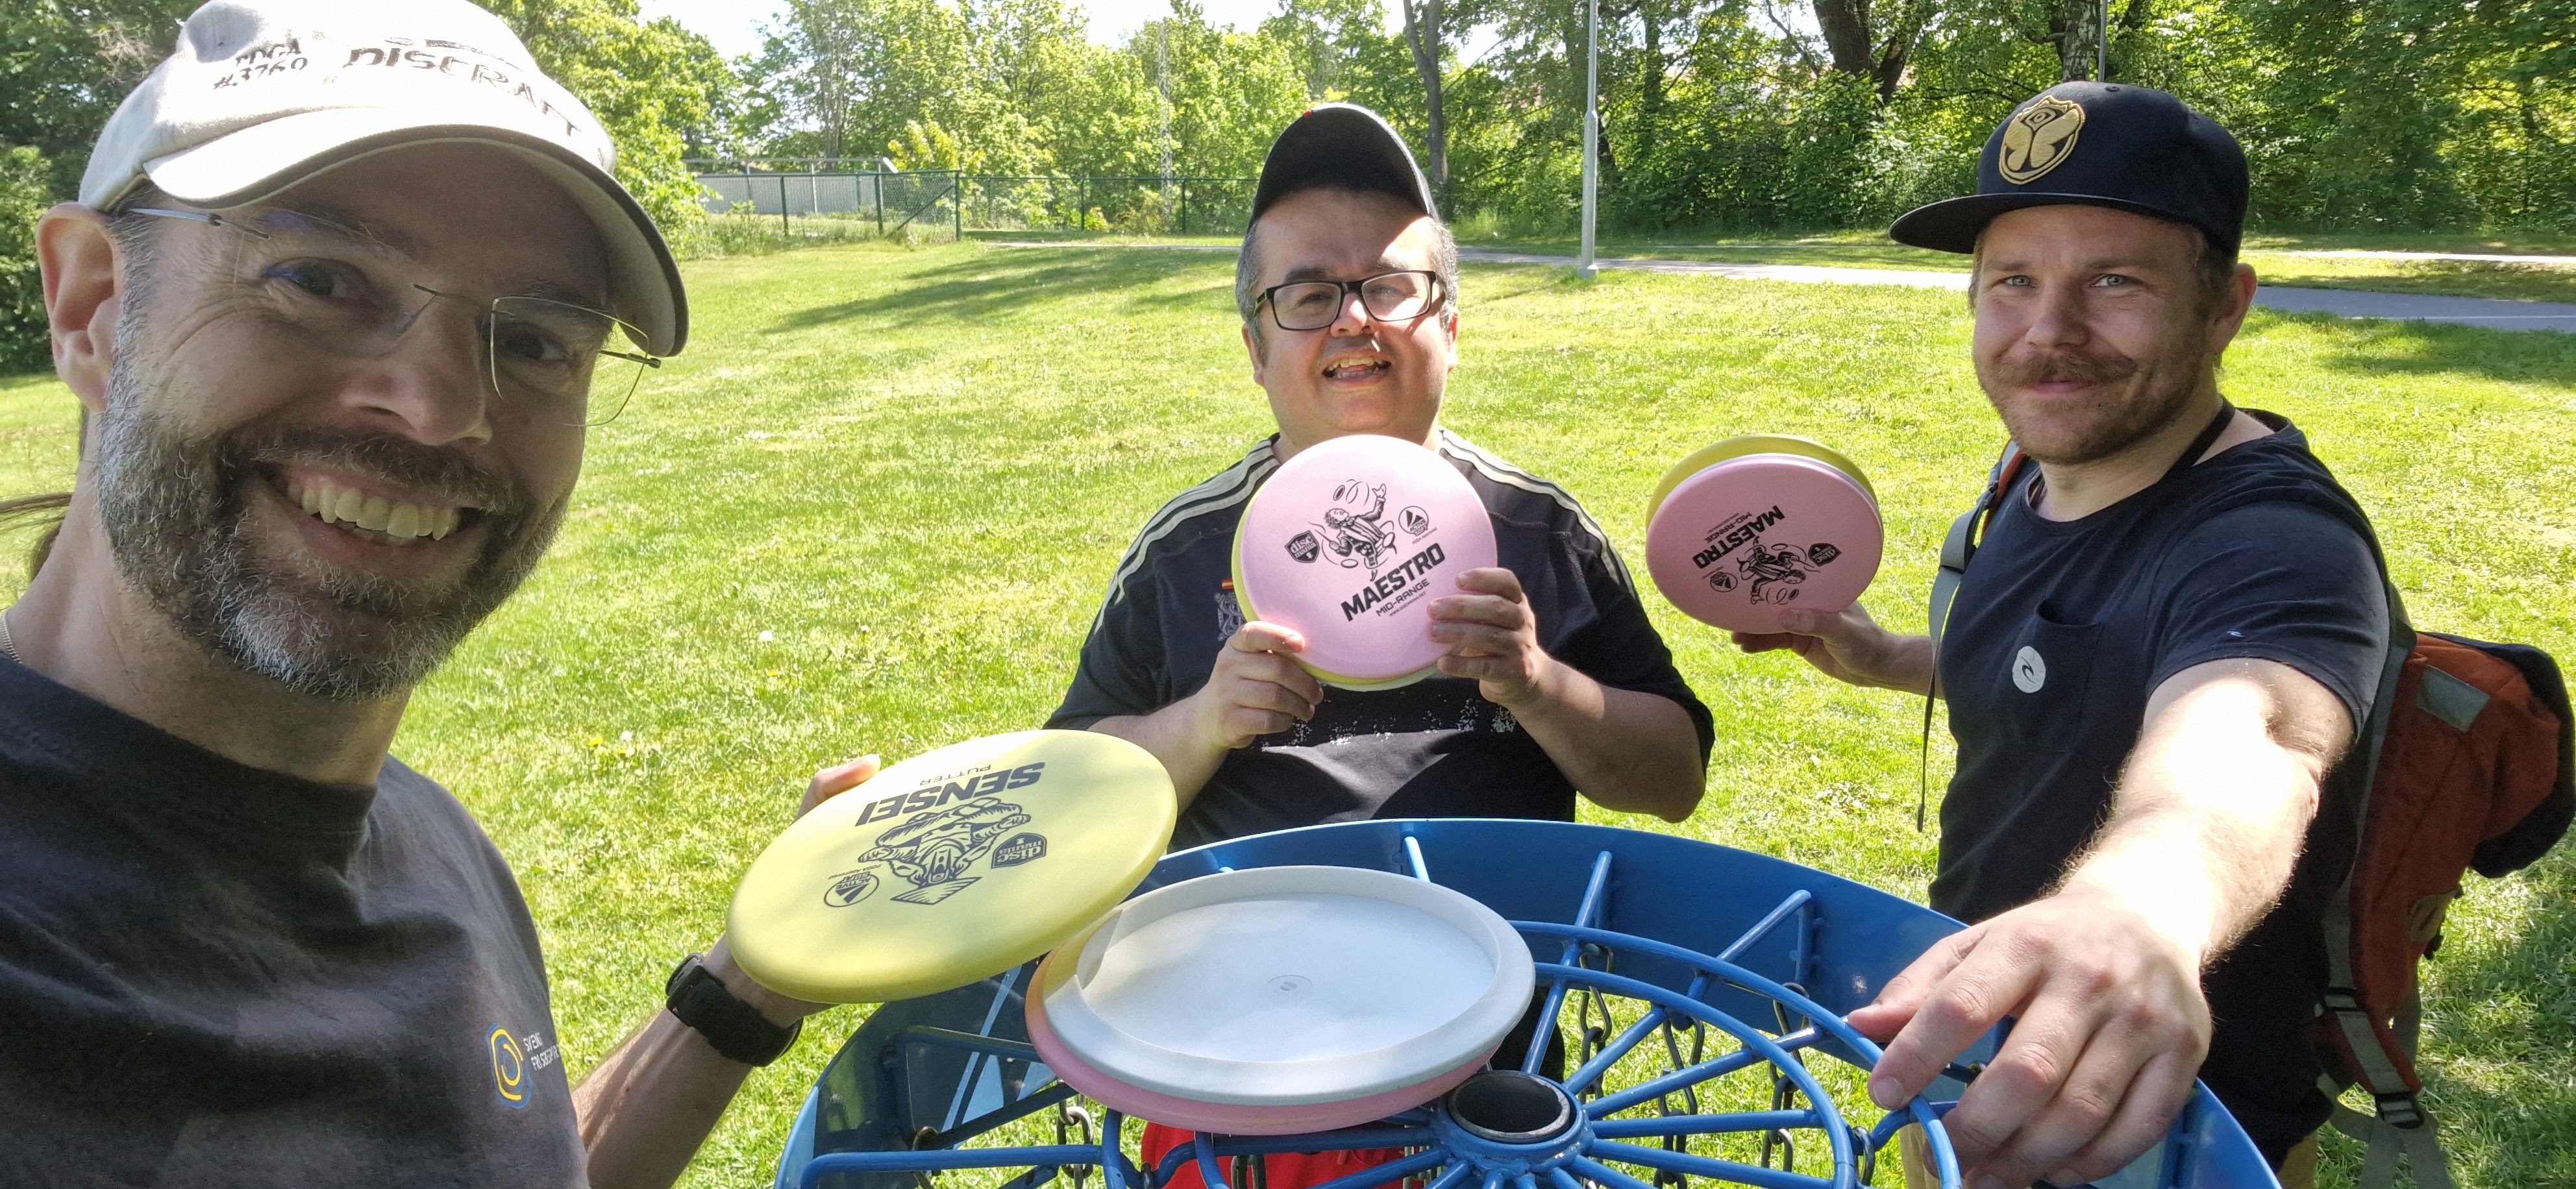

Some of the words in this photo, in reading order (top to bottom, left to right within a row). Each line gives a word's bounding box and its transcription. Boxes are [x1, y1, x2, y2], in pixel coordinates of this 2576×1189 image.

[1409, 518, 1426, 532] ACTIVE
[1704, 511, 1752, 544] MID-RANGE
[1290, 533, 1313, 554] disc
[1692, 505, 1785, 569] MAESTRO
[1294, 542, 1317, 559] mania
[1341, 543, 1445, 622] MAESTRO
[1376, 578, 1430, 617] MID-RANGE
[920, 764, 991, 786] PUTTER
[854, 762, 1045, 827] SENSEI
[997, 846, 1041, 863] disc
[836, 877, 872, 890] ACTIVE
[841, 872, 870, 883] SOFT
